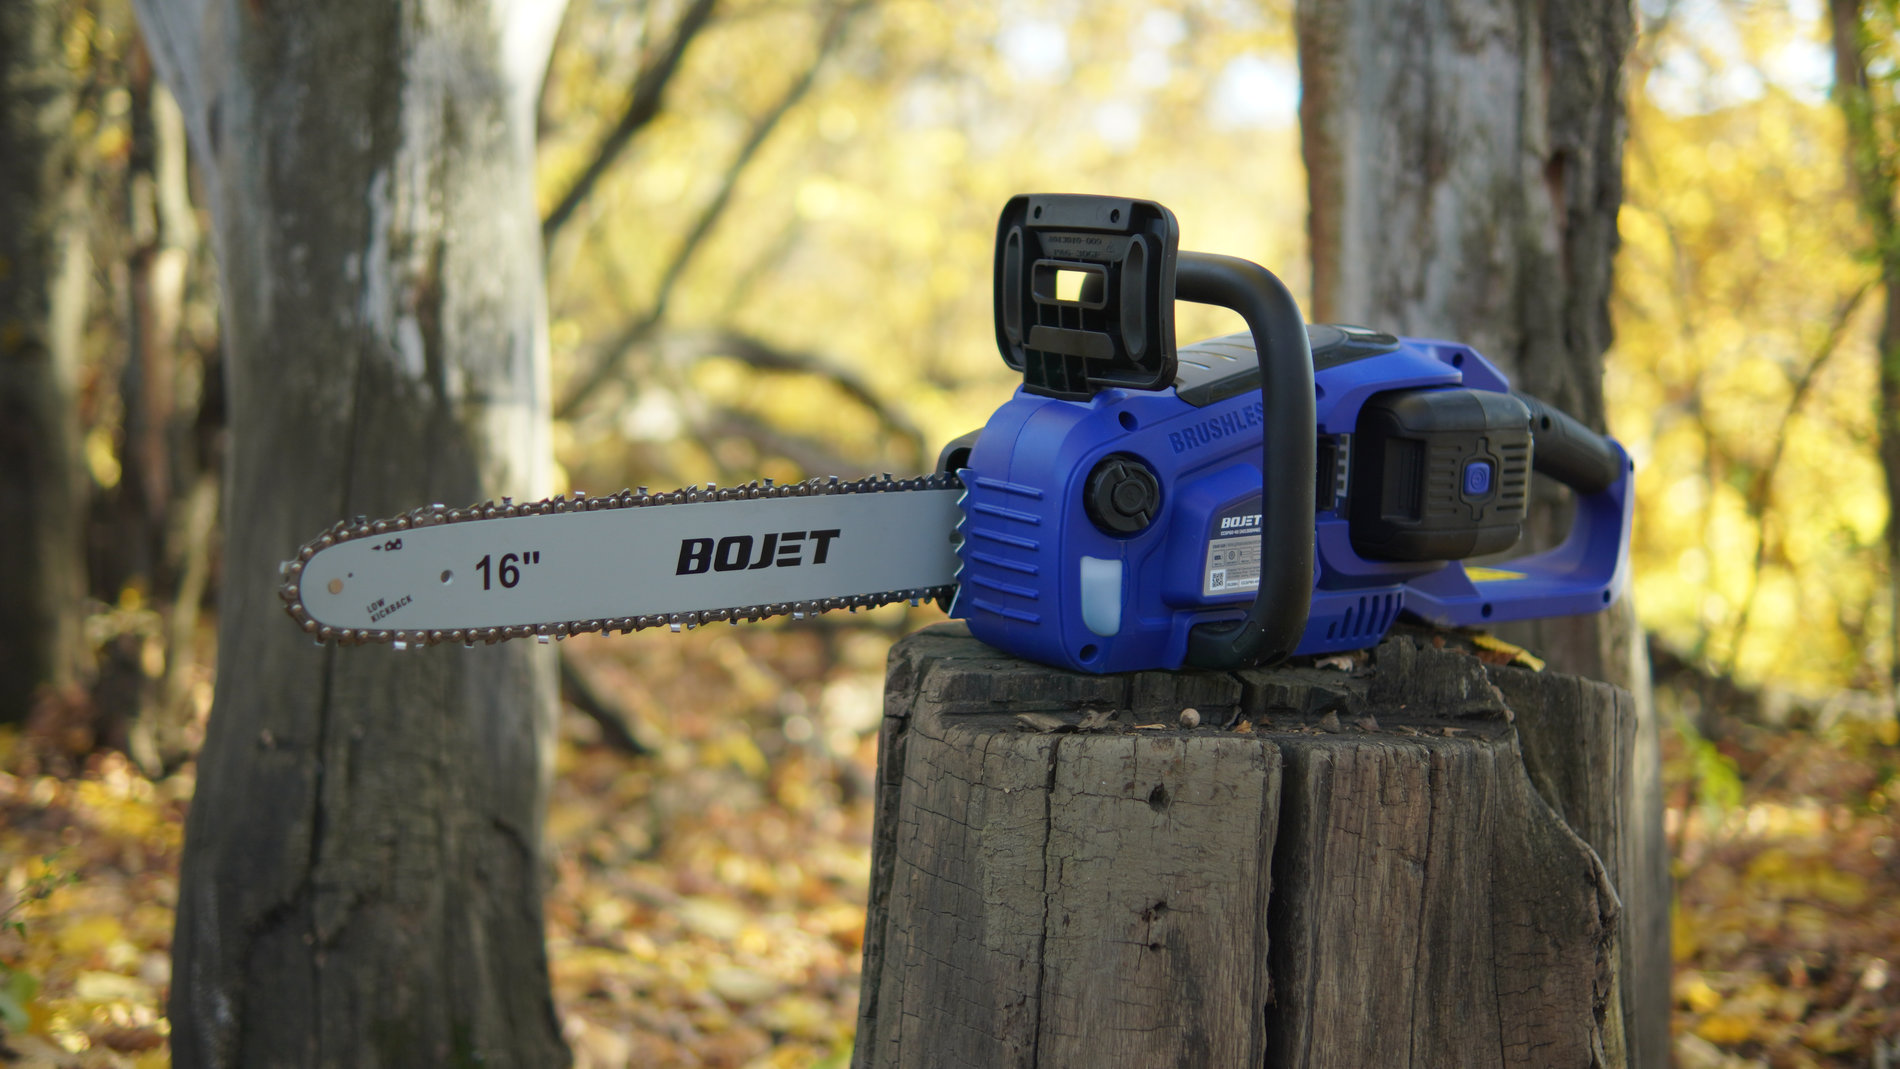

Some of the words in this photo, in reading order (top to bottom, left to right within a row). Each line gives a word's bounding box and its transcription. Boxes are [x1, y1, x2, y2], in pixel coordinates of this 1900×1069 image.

[1221, 515, 1262, 528] BOJET
[675, 529, 840, 575] BOJET
[475, 551, 541, 592] 16"
[366, 597, 385, 613] LOW
[370, 594, 413, 623] KICKBACK
